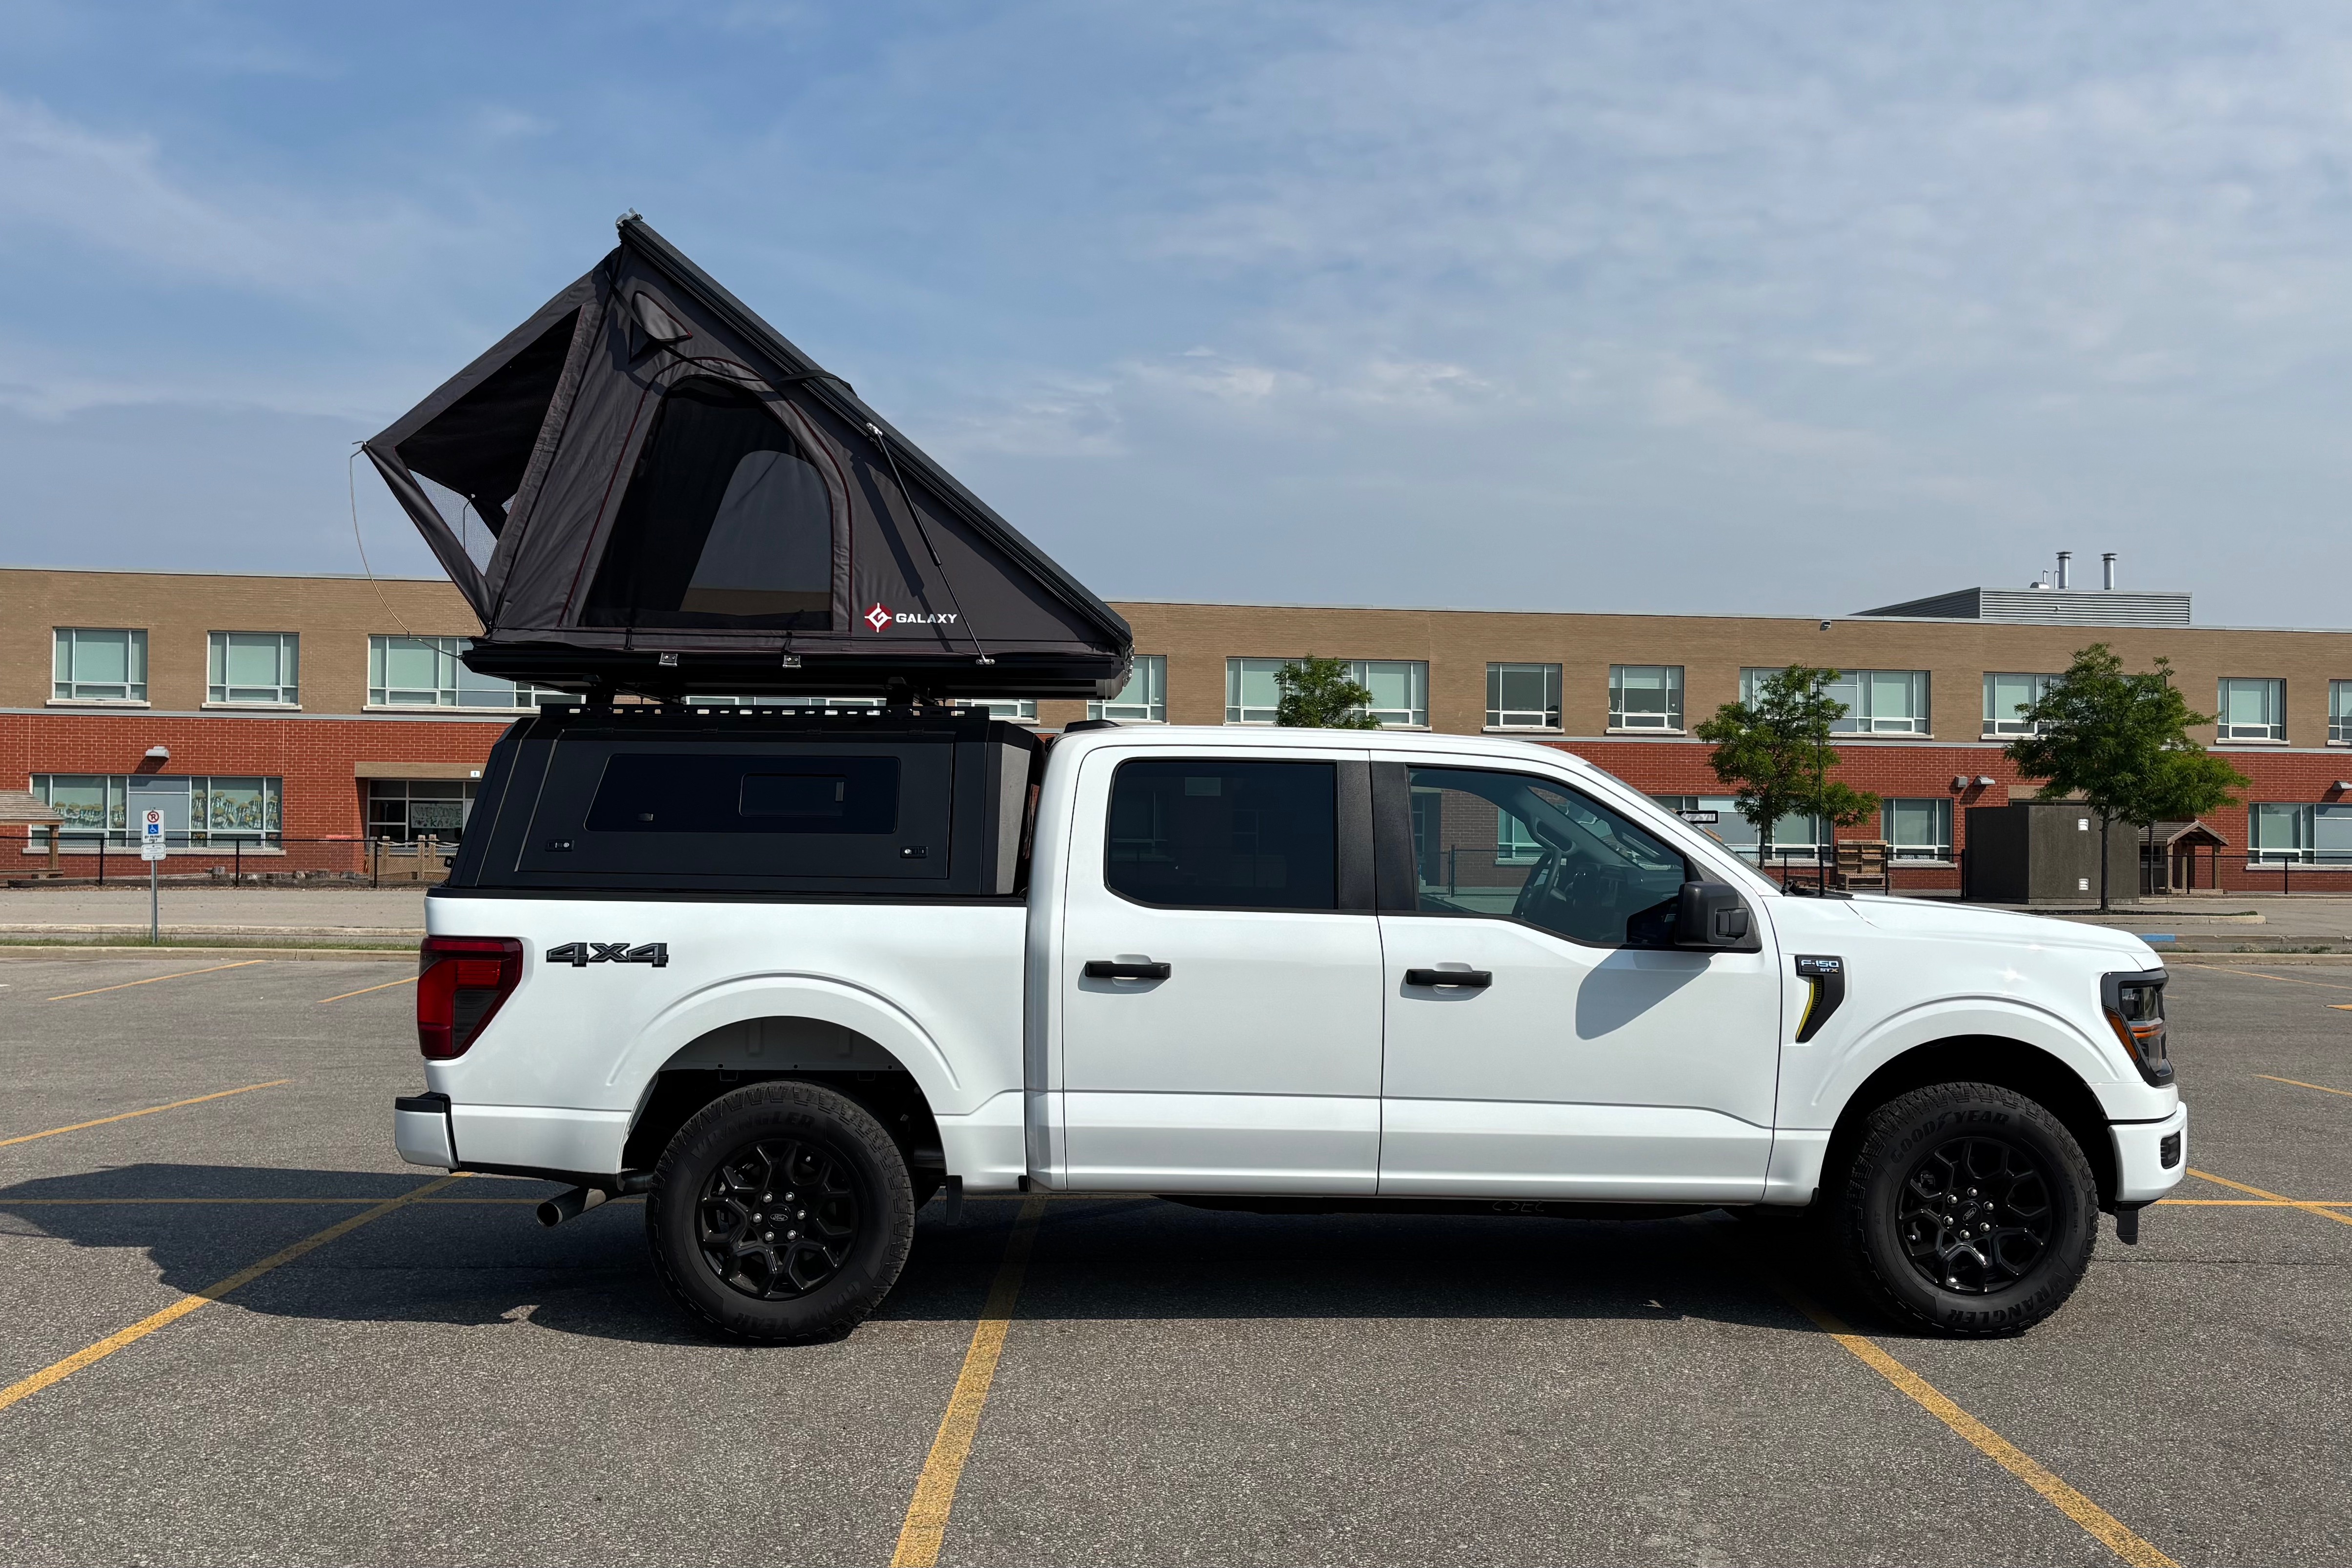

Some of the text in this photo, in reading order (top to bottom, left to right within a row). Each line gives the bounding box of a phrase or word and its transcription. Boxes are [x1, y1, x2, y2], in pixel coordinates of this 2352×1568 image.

[896, 613, 957, 624] GALAXY
[414, 806, 462, 818] WELCOME
[690, 1111, 815, 1159] WRANGLER
[1890, 1110, 2009, 1163] GOODYEAR
[1964, 1208, 1976, 1220] Ford
[1947, 1272, 2066, 1324] WRANGLER
